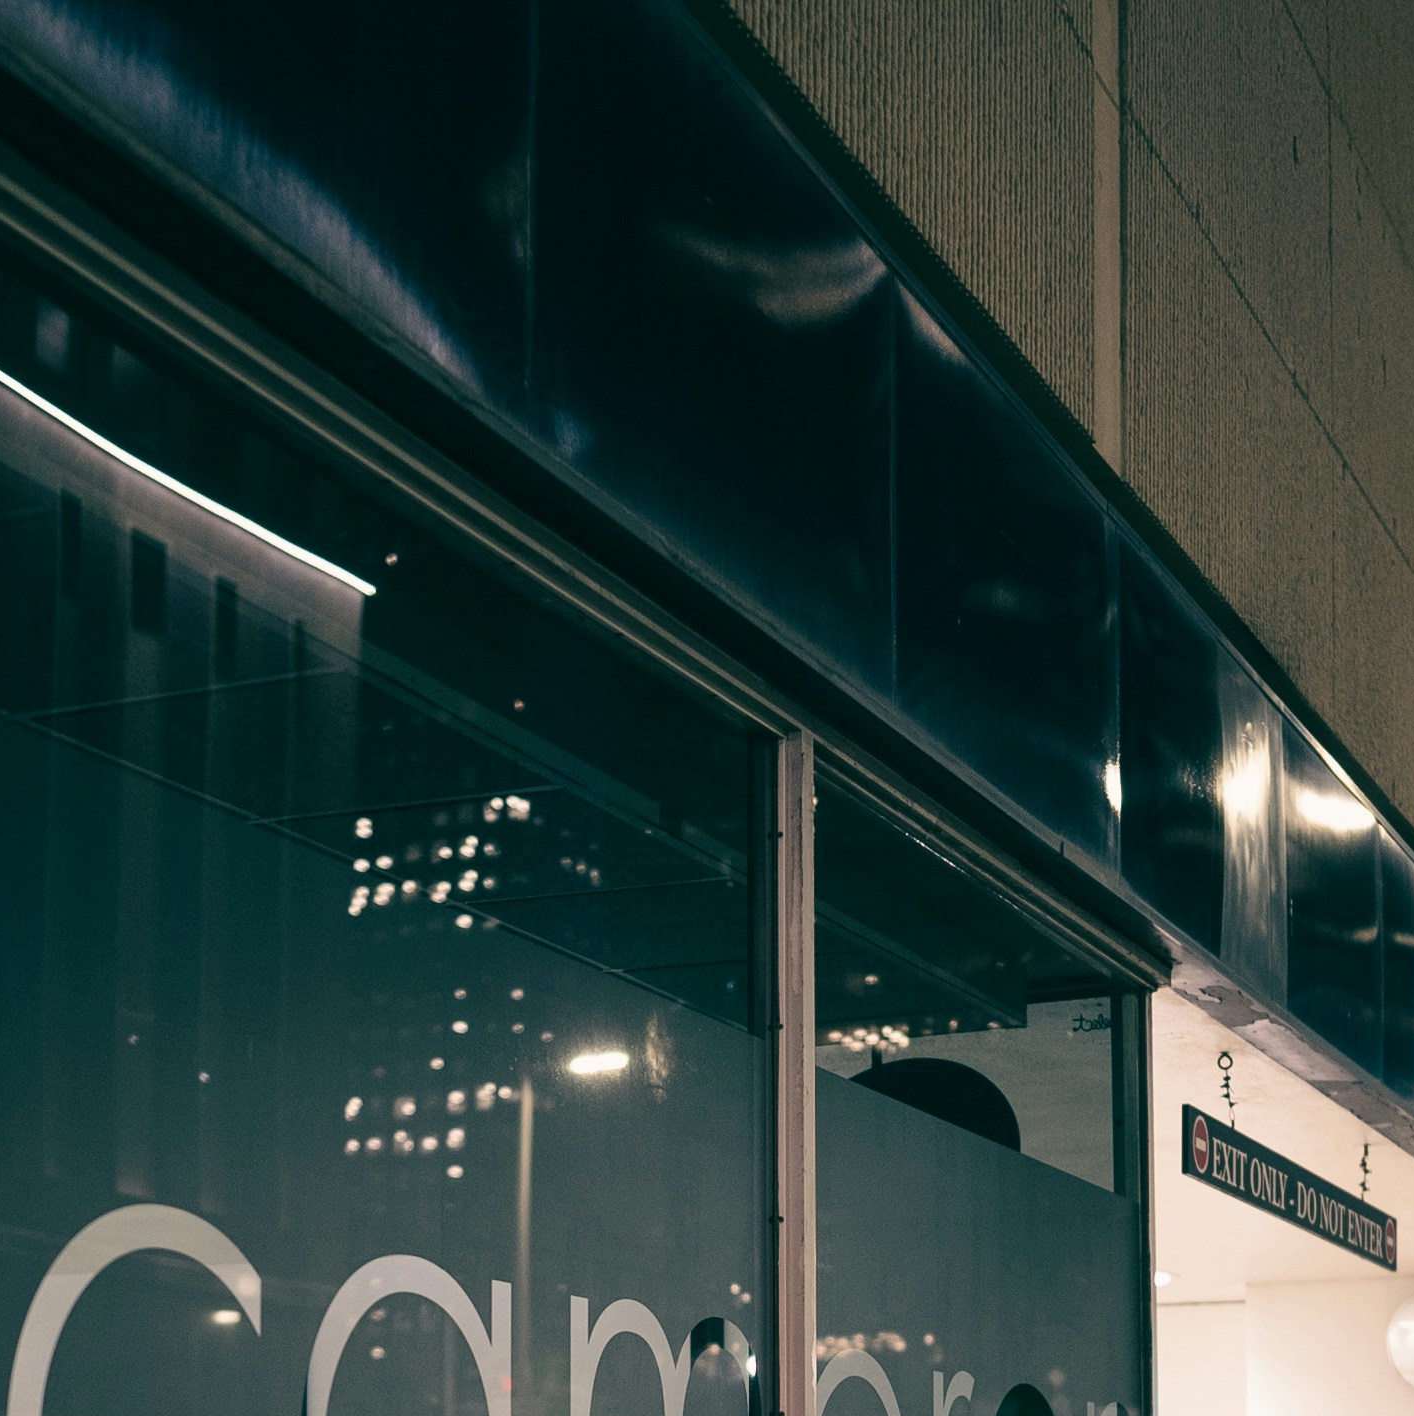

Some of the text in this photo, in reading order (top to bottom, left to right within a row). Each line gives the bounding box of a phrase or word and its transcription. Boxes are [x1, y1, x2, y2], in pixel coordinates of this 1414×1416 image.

[1212, 1137, 1247, 1191] EXIT
[1250, 1158, 1288, 1211] ONLY
[1297, 1181, 1317, 1225] DO
[1319, 1193, 1346, 1239] NOT
[1348, 1208, 1383, 1258] ENTER
